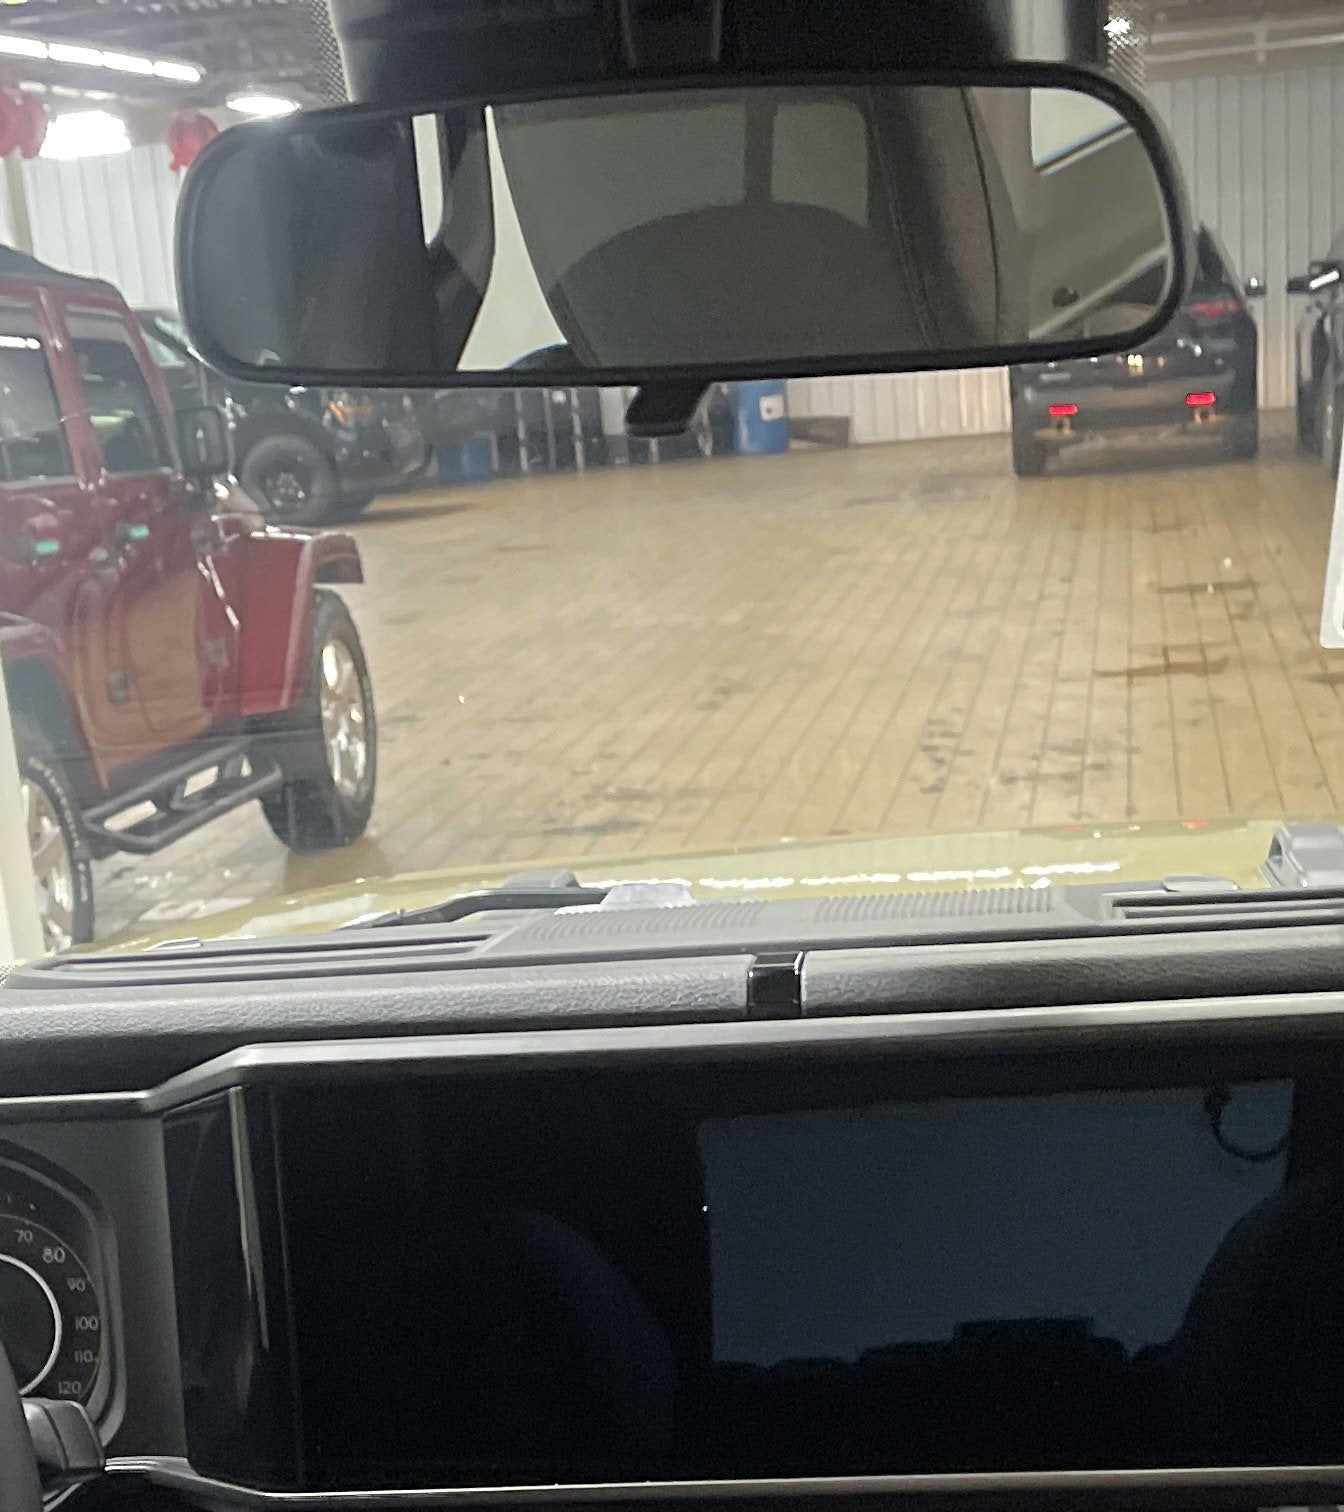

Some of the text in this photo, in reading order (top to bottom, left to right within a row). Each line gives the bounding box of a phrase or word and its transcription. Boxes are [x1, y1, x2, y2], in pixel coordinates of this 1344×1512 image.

[14, 1229, 34, 1244] 70
[41, 1247, 66, 1264] 80
[65, 1277, 86, 1292] 90
[74, 1315, 99, 1330] 100
[74, 1350, 95, 1363] 110
[57, 1380, 83, 1394] 120
